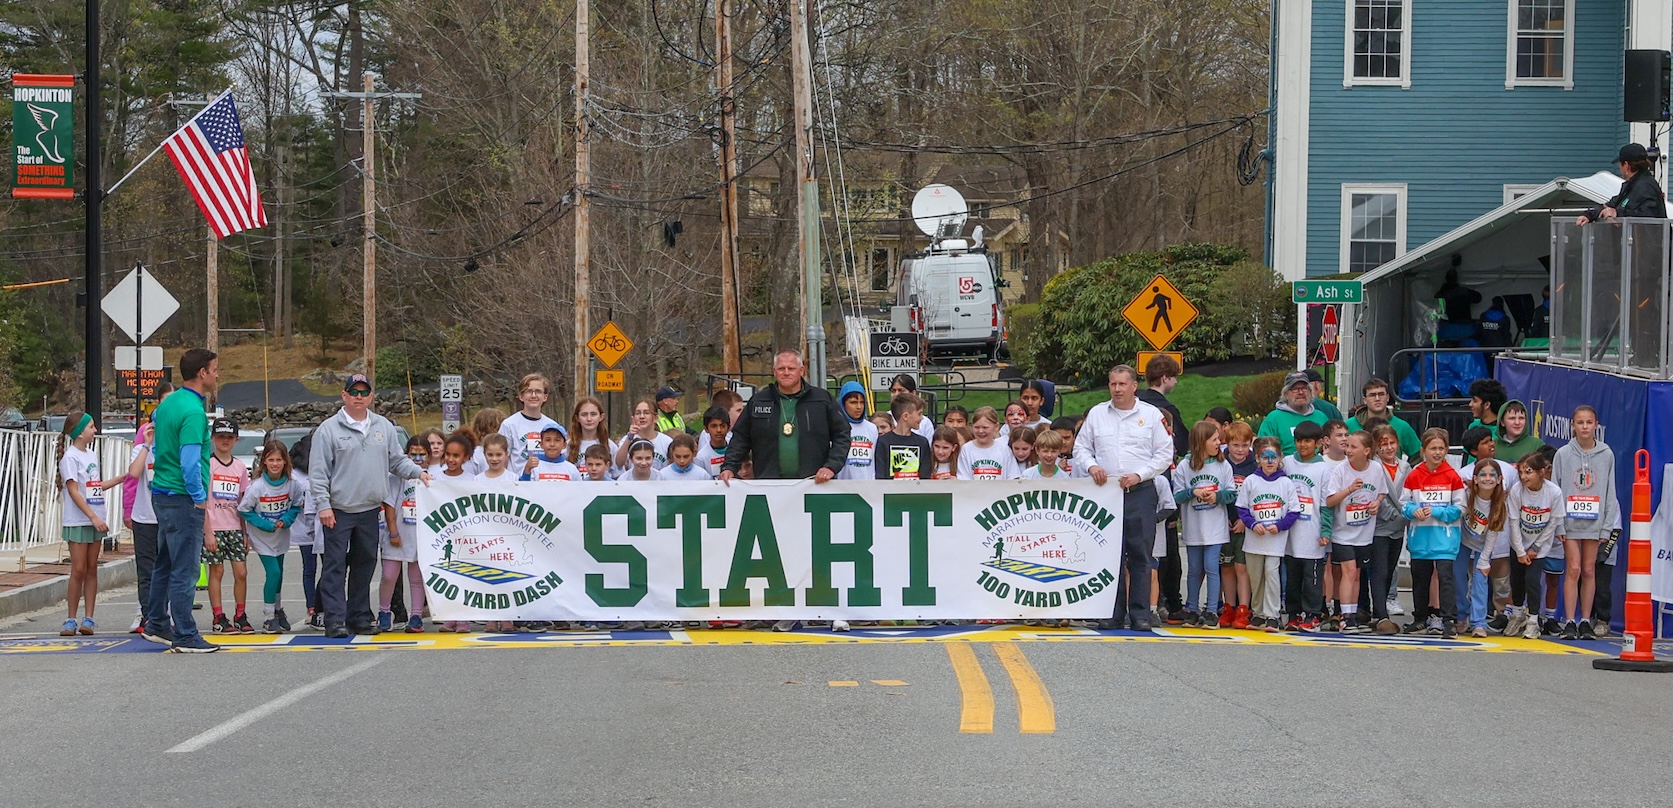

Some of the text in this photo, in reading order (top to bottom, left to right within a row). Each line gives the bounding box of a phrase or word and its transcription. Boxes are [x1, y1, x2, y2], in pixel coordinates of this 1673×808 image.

[14, 88, 72, 102] HOPKINTON
[17, 146, 30, 154] The
[17, 155, 43, 164] Start of
[17, 165, 64, 176] SOMETHING
[17, 176, 65, 186] Extraordinary
[1316, 286, 1353, 298] Ash St
[1324, 324, 1337, 344] STOP
[872, 359, 916, 368] BIKE LANE
[881, 377, 894, 386] EN
[442, 388, 460, 399] 25
[852, 448, 868, 457] 064
[1190, 474, 1220, 486] HOPKINTON
[93, 488, 102, 496] 22
[221, 482, 236, 491] 107
[1253, 494, 1286, 506] HOPKINTON
[1426, 492, 1443, 500] 221
[268, 502, 284, 511] 135
[974, 490, 1115, 532] HOPKINTON
[1574, 502, 1592, 511] 095
[423, 493, 561, 534] HOPKINTON
[1259, 510, 1276, 519] 004
[1354, 511, 1369, 520] 015
[1526, 514, 1542, 522] 091
[431, 514, 555, 550] MARATHON COMMITTEE
[982, 512, 1107, 548] MARATHON COMMITTEE
[469, 537, 504, 555] STARTS
[1020, 534, 1057, 552] STARTS
[583, 493, 952, 607] START
[1657, 549, 1673, 561] BA
[490, 552, 514, 561] HERE
[435, 561, 528, 581] START
[986, 560, 1081, 579] START
[426, 571, 564, 609] 100 YARD DASH
[976, 568, 1115, 607] 100 YARD DASH
